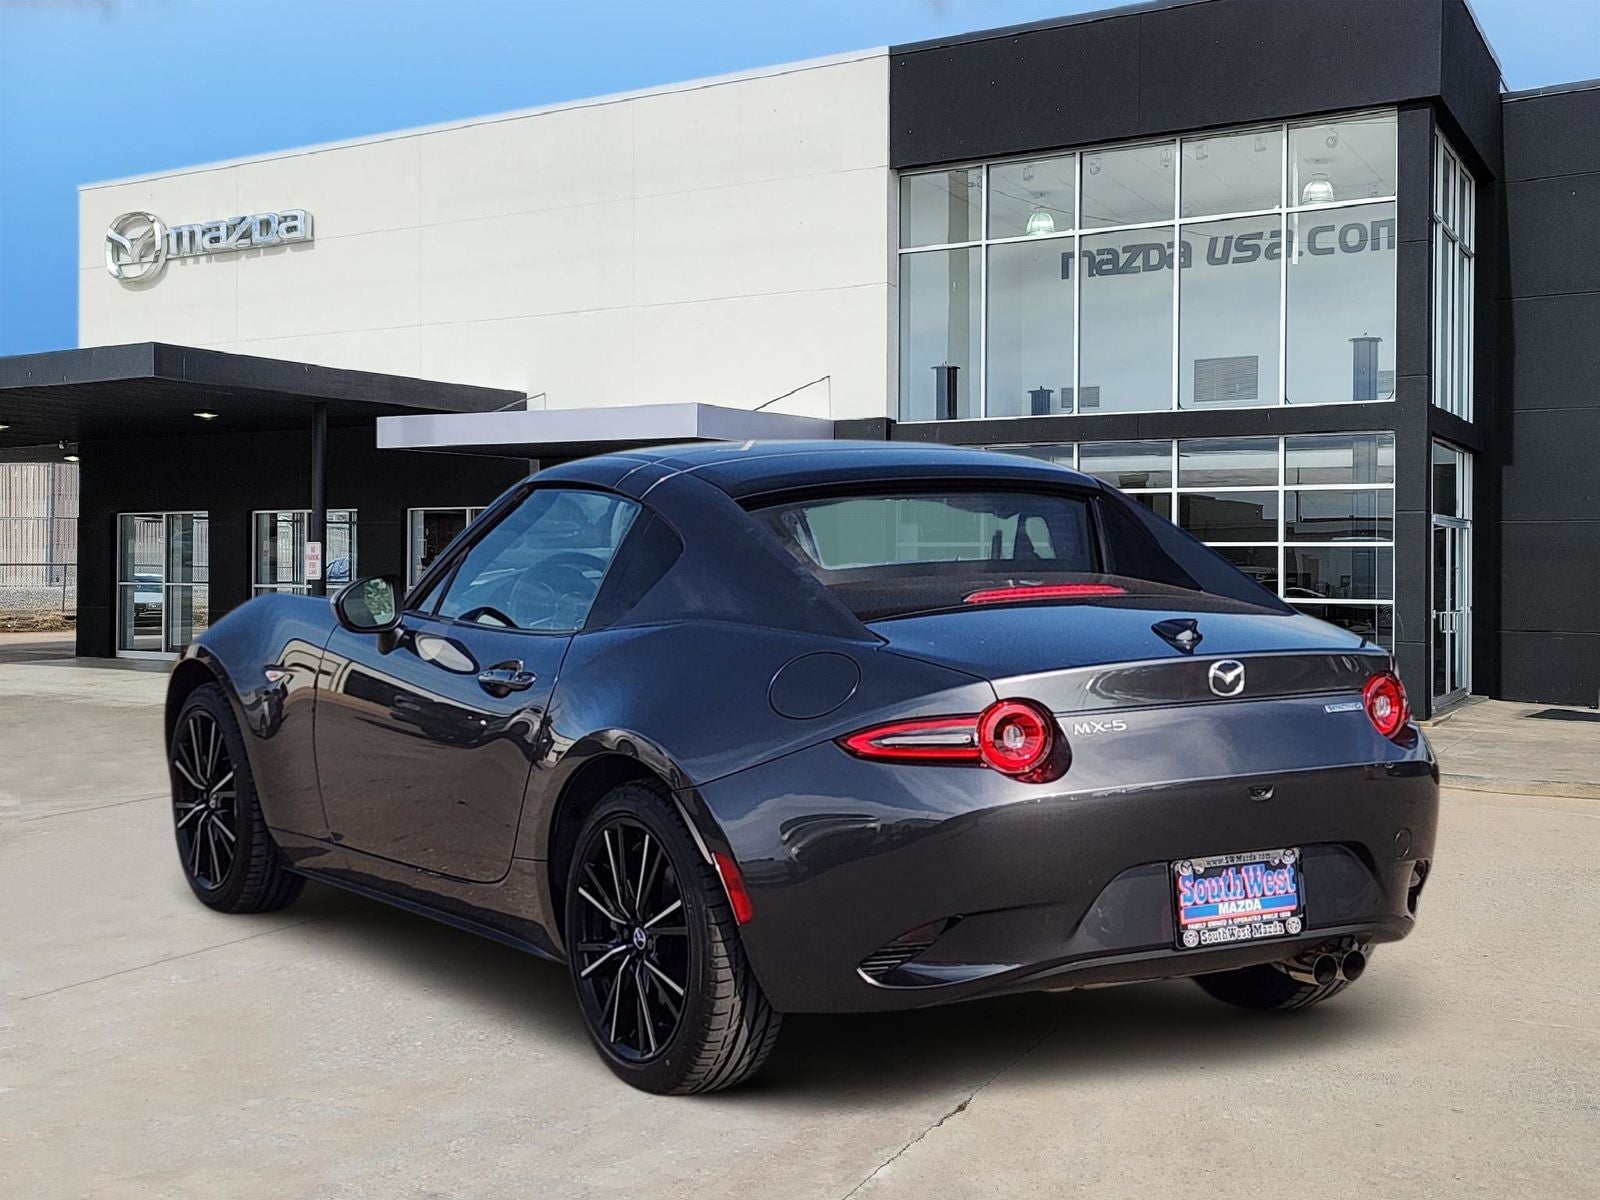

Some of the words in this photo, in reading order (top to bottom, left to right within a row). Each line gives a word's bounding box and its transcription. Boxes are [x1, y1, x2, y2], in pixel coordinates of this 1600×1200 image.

[167, 209, 314, 256] mazda
[1061, 240, 1193, 280] mazda
[1073, 719, 1127, 735] MX-5
[1218, 898, 1262, 915] MAZDA
[1201, 925, 1252, 944] SouthWest
[1252, 921, 1285, 938] Mazda
